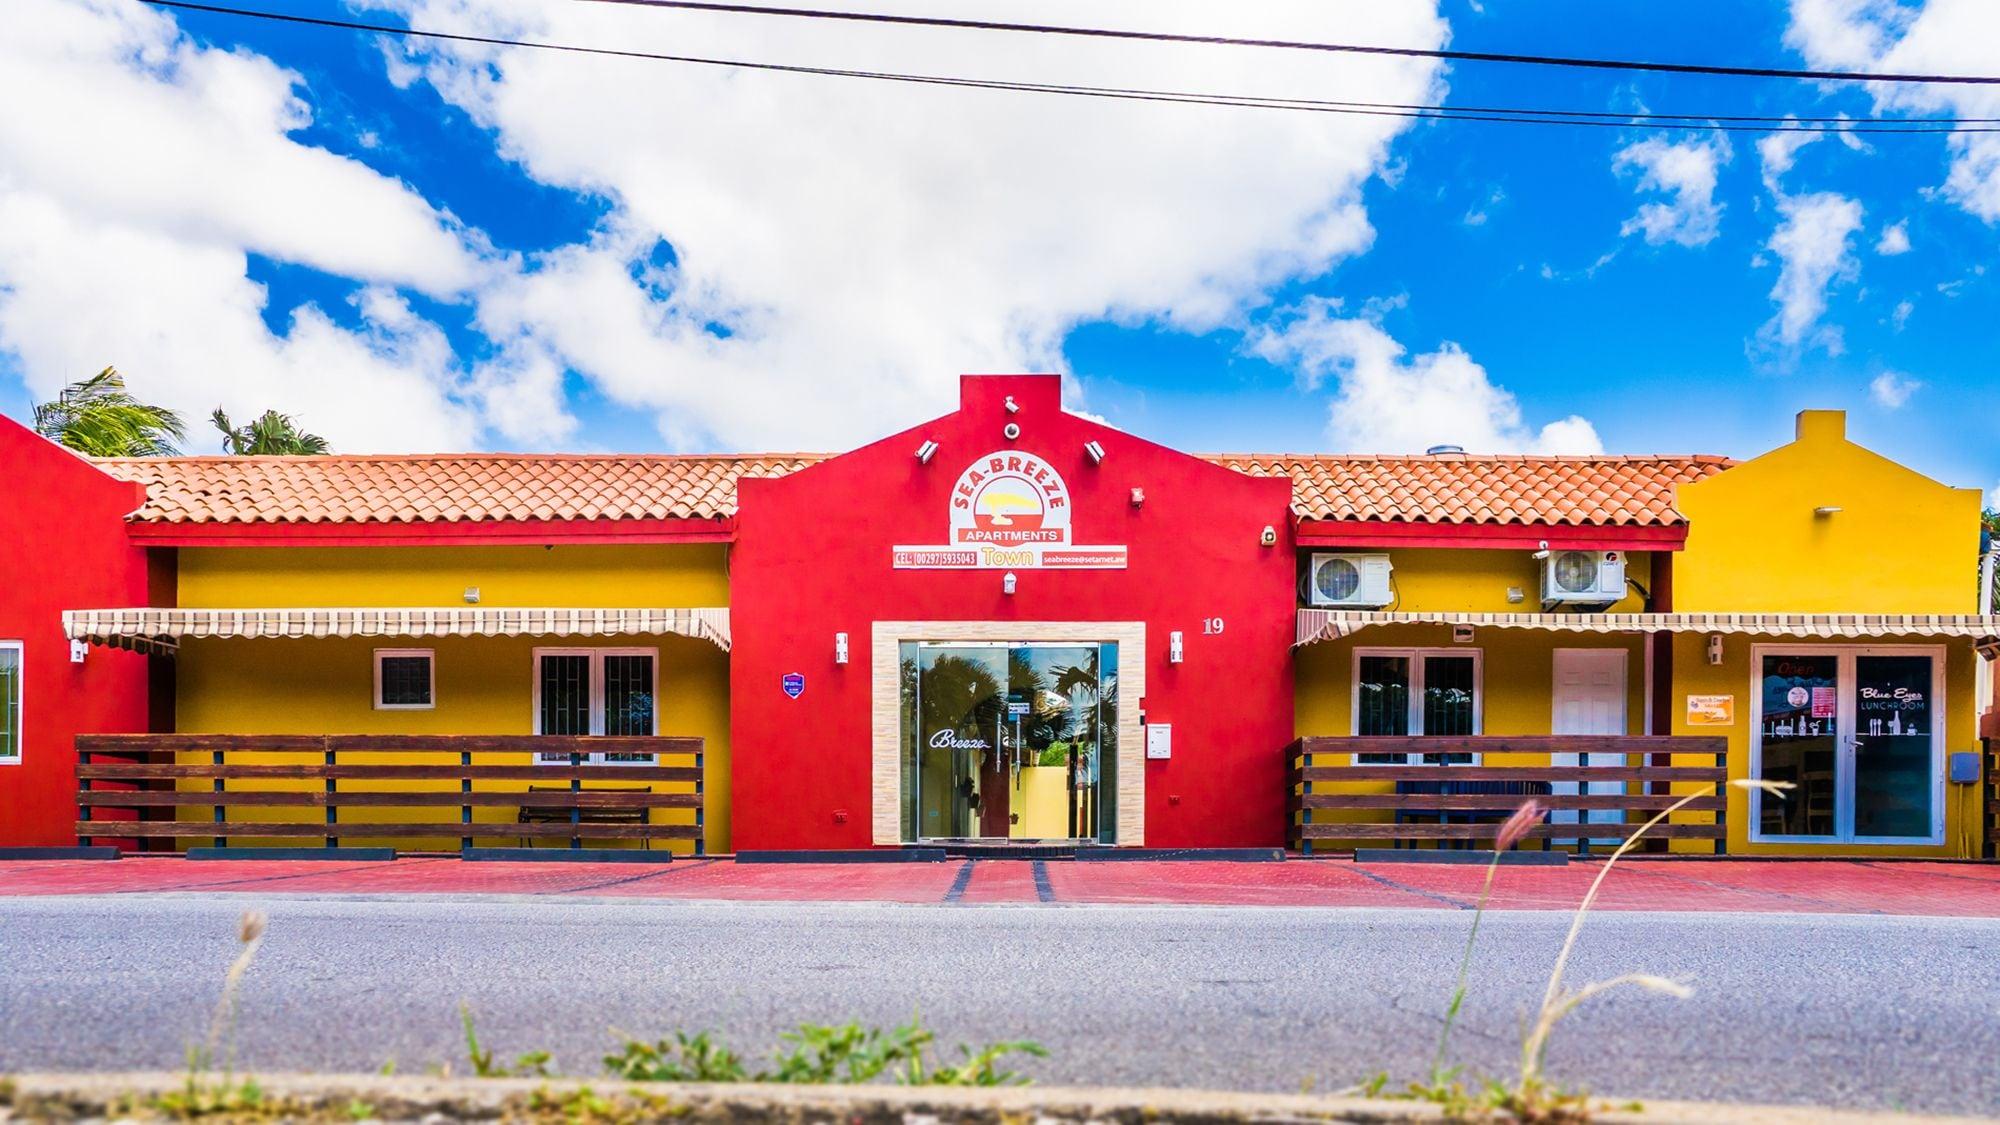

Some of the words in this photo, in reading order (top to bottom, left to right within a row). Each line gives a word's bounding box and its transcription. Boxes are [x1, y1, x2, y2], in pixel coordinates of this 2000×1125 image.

[955, 457, 1064, 509] SEA-BREEZE
[966, 531, 1057, 541] APARTMENTS
[895, 552, 913, 564] CEL:
[981, 547, 1033, 566] Town
[1203, 618, 1224, 634] 19
[1861, 687, 1891, 699] Blue
[1893, 688, 1923, 702] Eyes
[1861, 701, 1924, 710] LUNCHROOM
[929, 729, 992, 748] Breeze
